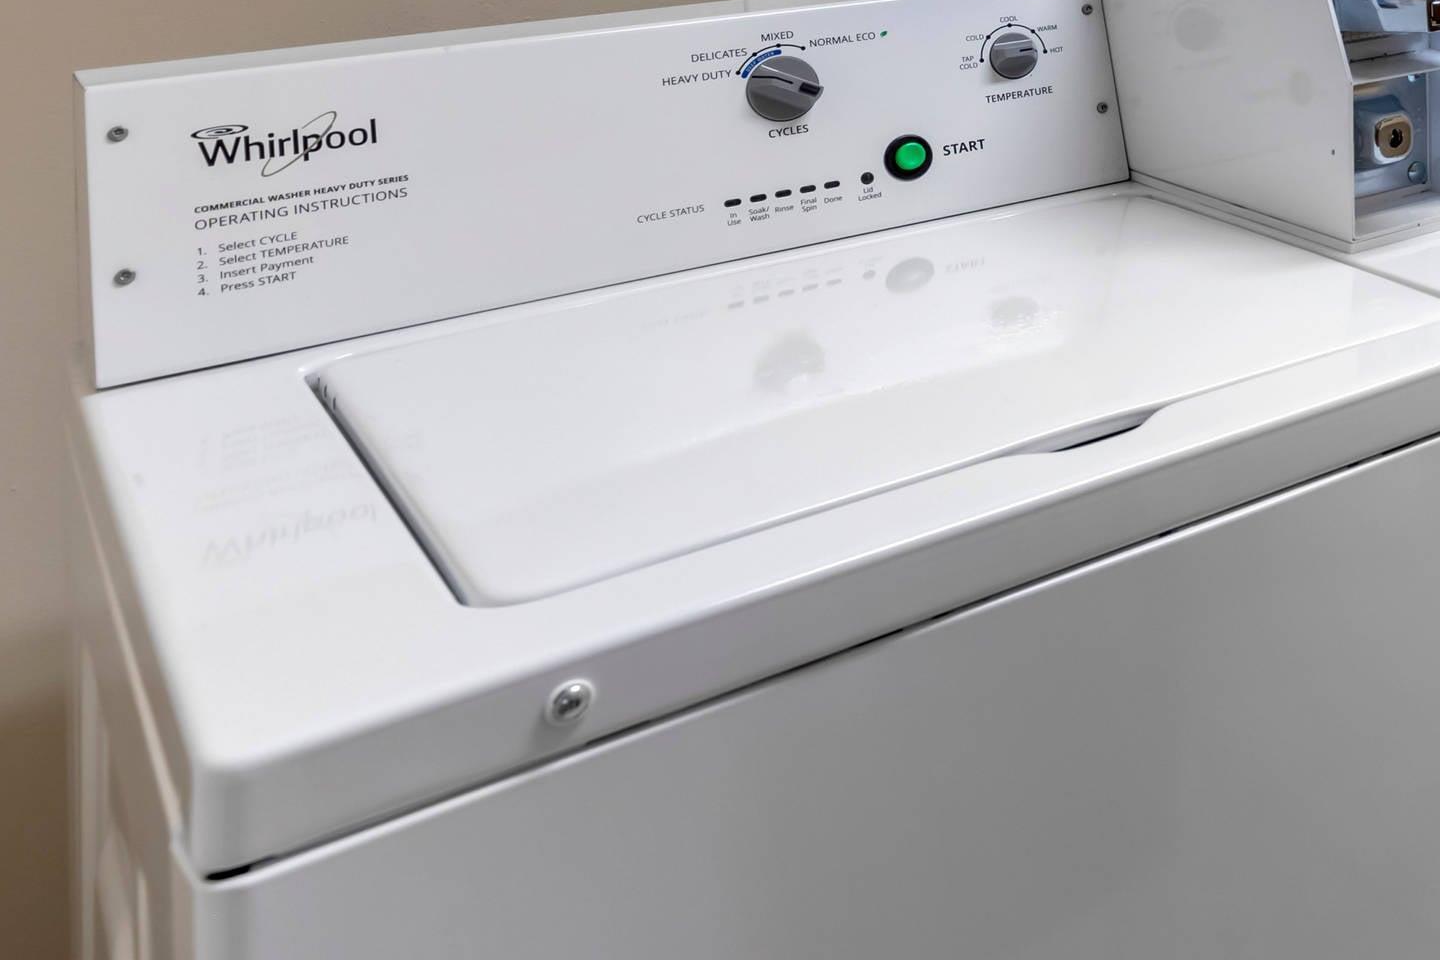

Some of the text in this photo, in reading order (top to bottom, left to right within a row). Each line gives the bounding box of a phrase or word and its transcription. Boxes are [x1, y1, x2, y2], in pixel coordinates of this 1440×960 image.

[1000, 15, 1018, 23] COOL
[1037, 24, 1058, 32] WARM
[760, 30, 794, 42] MIXED
[809, 31, 876, 48] NORMAL ECO
[965, 34, 984, 42] COLD
[690, 47, 748, 63] DELICATES
[959, 62, 978, 70] COLD
[662, 69, 732, 87] HEAVY DUTY
[985, 85, 1053, 104] TEMPERATURE
[768, 124, 809, 139] CYCLES
[198, 118, 378, 167] Whirlpool
[942, 138, 986, 157] START
[193, 174, 409, 214] COMMERCIAL WASHER HEAVY DUTY SERIES
[863, 185, 874, 194] Lid
[800, 196, 817, 206] Final
[823, 195, 843, 205] Done
[857, 191, 882, 202] Locked
[194, 187, 409, 231] OPERATING INSTRUCTIONS
[636, 204, 705, 224] CYCLE STATUS
[748, 205, 770, 216] Soak/
[774, 203, 794, 214] Rinse
[801, 204, 818, 214] Spin
[727, 219, 742, 227] Use
[749, 213, 770, 222] Wash
[197, 231, 298, 256] 1. Select CYCLE
[197, 236, 349, 270] 2. Select TEMPERATURE
[197, 256, 314, 284] 3. Insert Payment
[197, 271, 297, 296] 4. Press START
